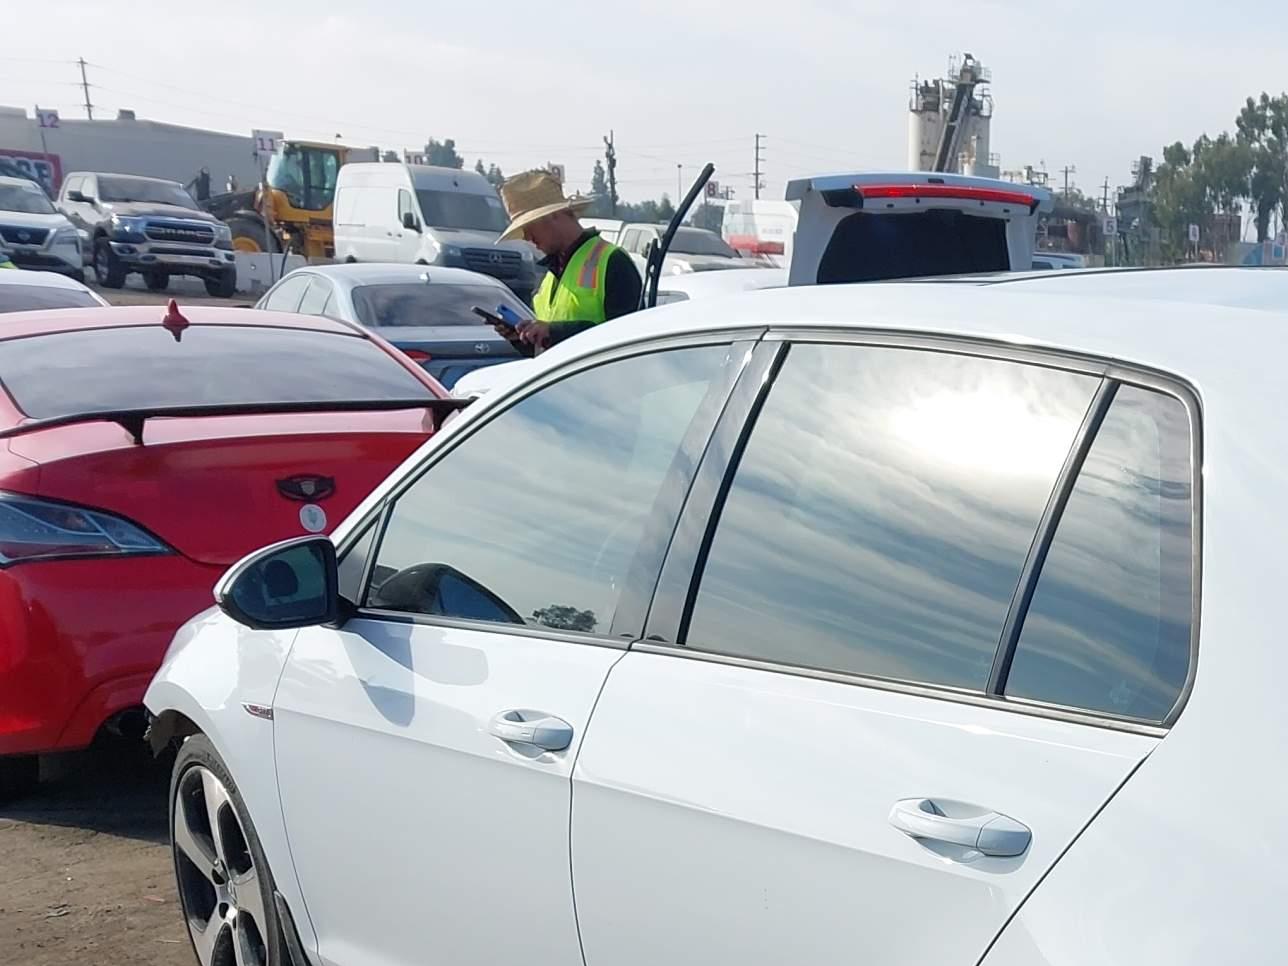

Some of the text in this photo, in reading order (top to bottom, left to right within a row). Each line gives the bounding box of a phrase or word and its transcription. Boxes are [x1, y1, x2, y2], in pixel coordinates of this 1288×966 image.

[38, 113, 60, 129] 12
[258, 137, 278, 152] 11
[707, 182, 717, 197] 8
[1106, 220, 1115, 232] 5
